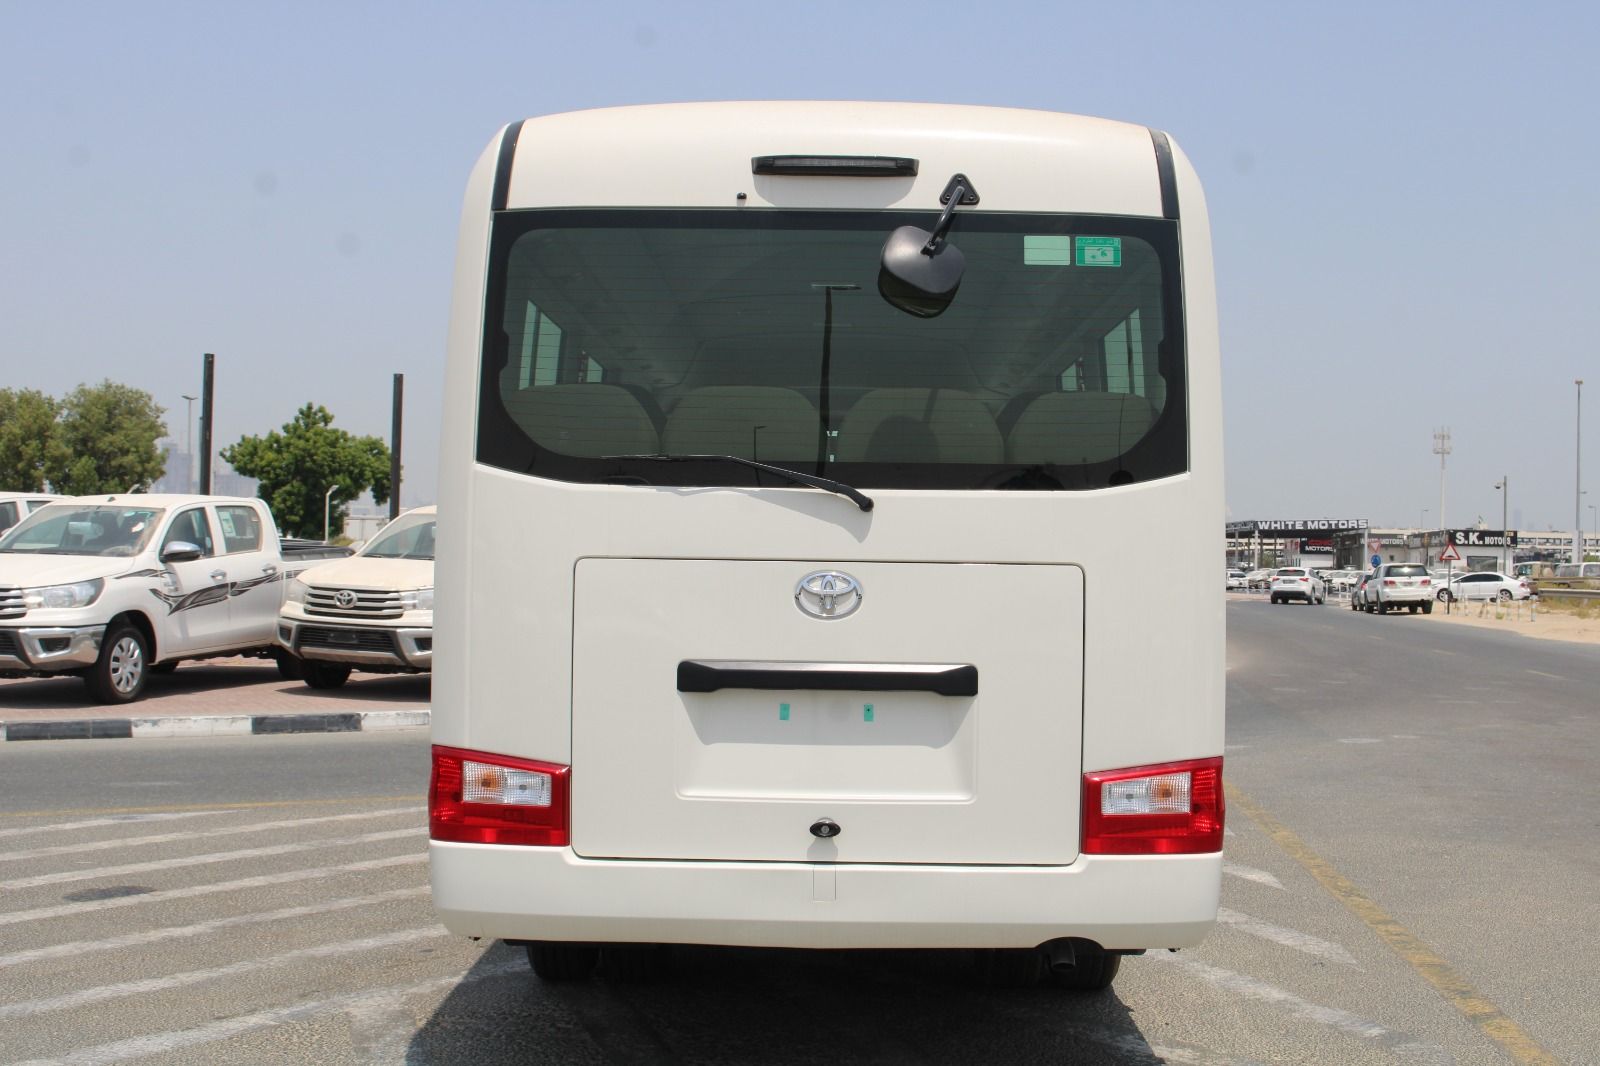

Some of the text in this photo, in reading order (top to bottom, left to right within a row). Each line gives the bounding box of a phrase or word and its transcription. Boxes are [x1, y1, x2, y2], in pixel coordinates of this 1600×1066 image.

[1257, 520, 1304, 530] WHITE
[1307, 519, 1368, 530] MOTORS
[1455, 531, 1483, 545] S.K.
